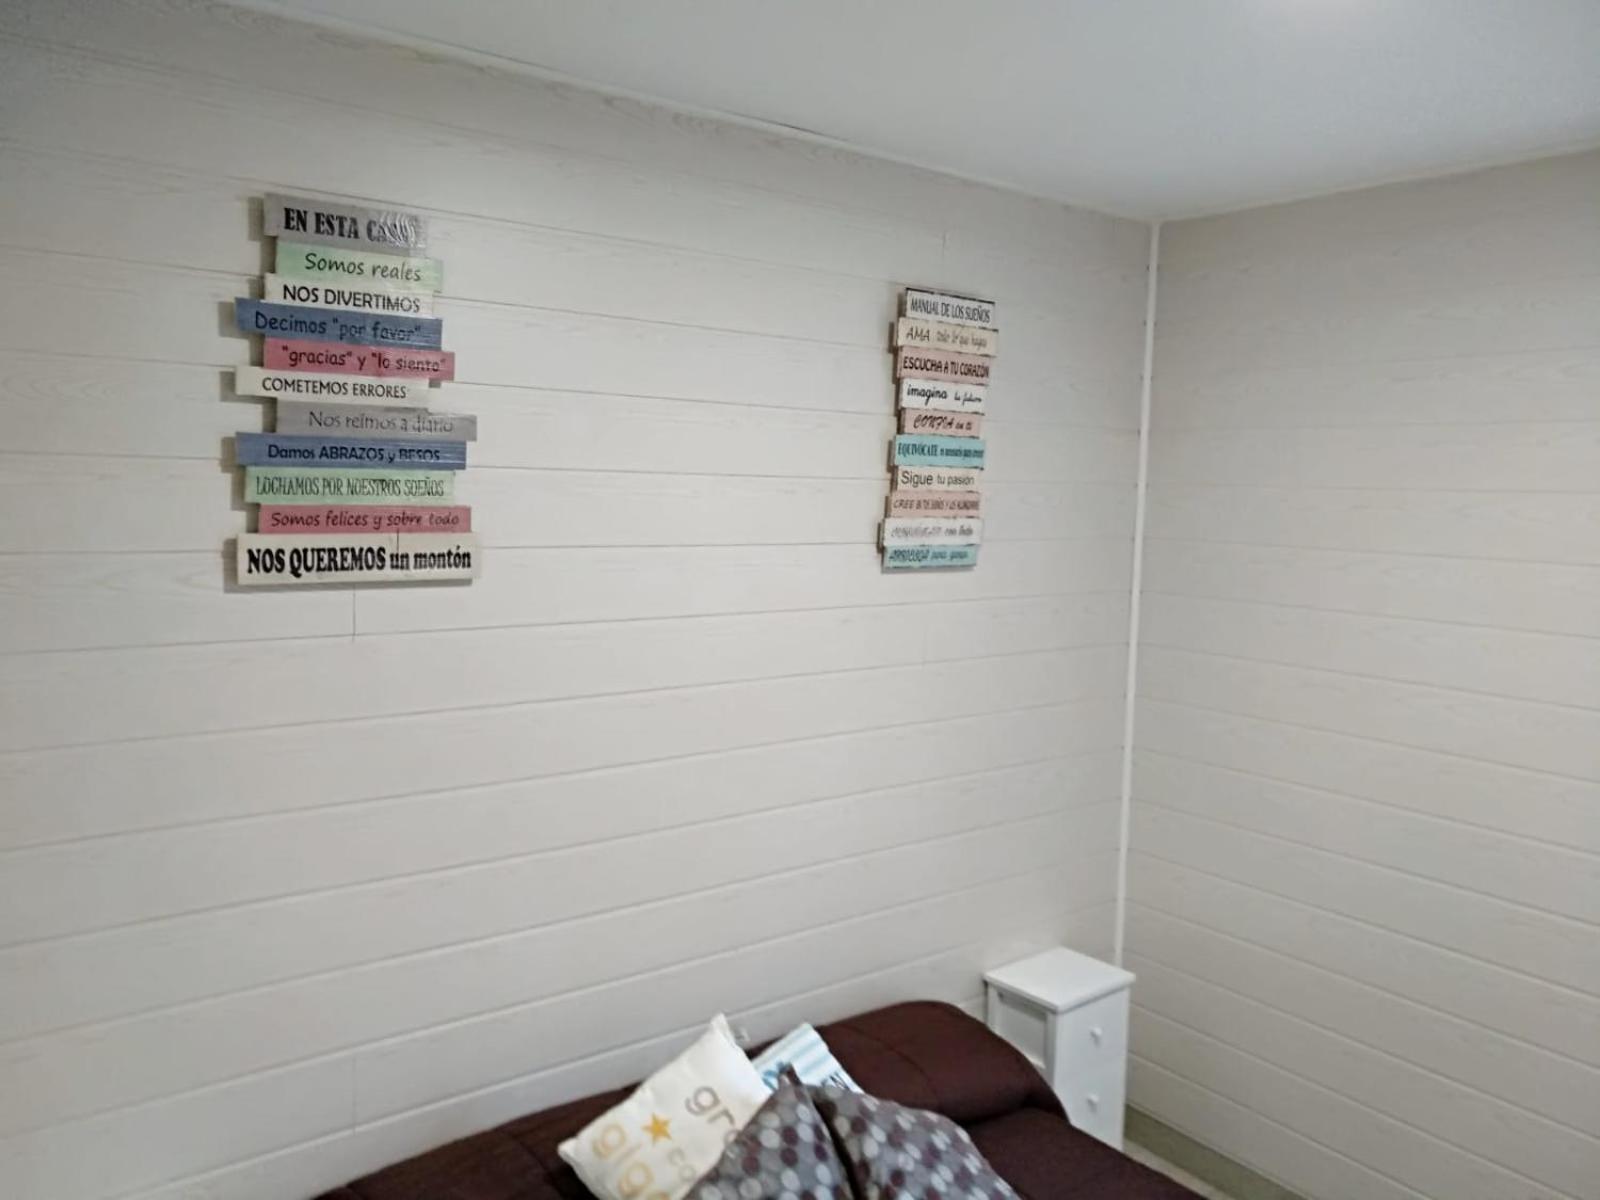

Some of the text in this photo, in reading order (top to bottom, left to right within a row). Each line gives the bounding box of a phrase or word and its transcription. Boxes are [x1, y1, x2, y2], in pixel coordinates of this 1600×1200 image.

[283, 207, 308, 233] EN
[314, 211, 360, 240] ESTA
[305, 253, 422, 282] Somos reales
[283, 284, 421, 313] NOS DIVERTIMOS
[910, 297, 939, 316] MANUAL
[941, 302, 951, 317] DE
[952, 304, 964, 320] LOS
[255, 311, 327, 334] Decimos
[332, 319, 366, 340] "por
[905, 327, 931, 342] AMA
[282, 345, 353, 368] "gracias"
[357, 356, 367, 370] y
[371, 352, 390, 369] "lo
[903, 356, 942, 373] ESCUCHA
[943, 360, 949, 373] A
[950, 361, 959, 375] TU
[262, 377, 407, 400] COMETEMOS ERRORES
[906, 384, 948, 406] imagina
[308, 411, 341, 428] Nos
[400, 419, 408, 431] a
[267, 444, 315, 460] Damos
[318, 446, 385, 461] ABRAZOS
[388, 450, 396, 464] y
[322, 477, 343, 497] POR
[900, 469, 933, 488] Sigue
[937, 474, 946, 484] tu
[271, 509, 459, 531] Somos felices y sobre todo
[247, 545, 471, 578] NOS QUEREMOS un montón
